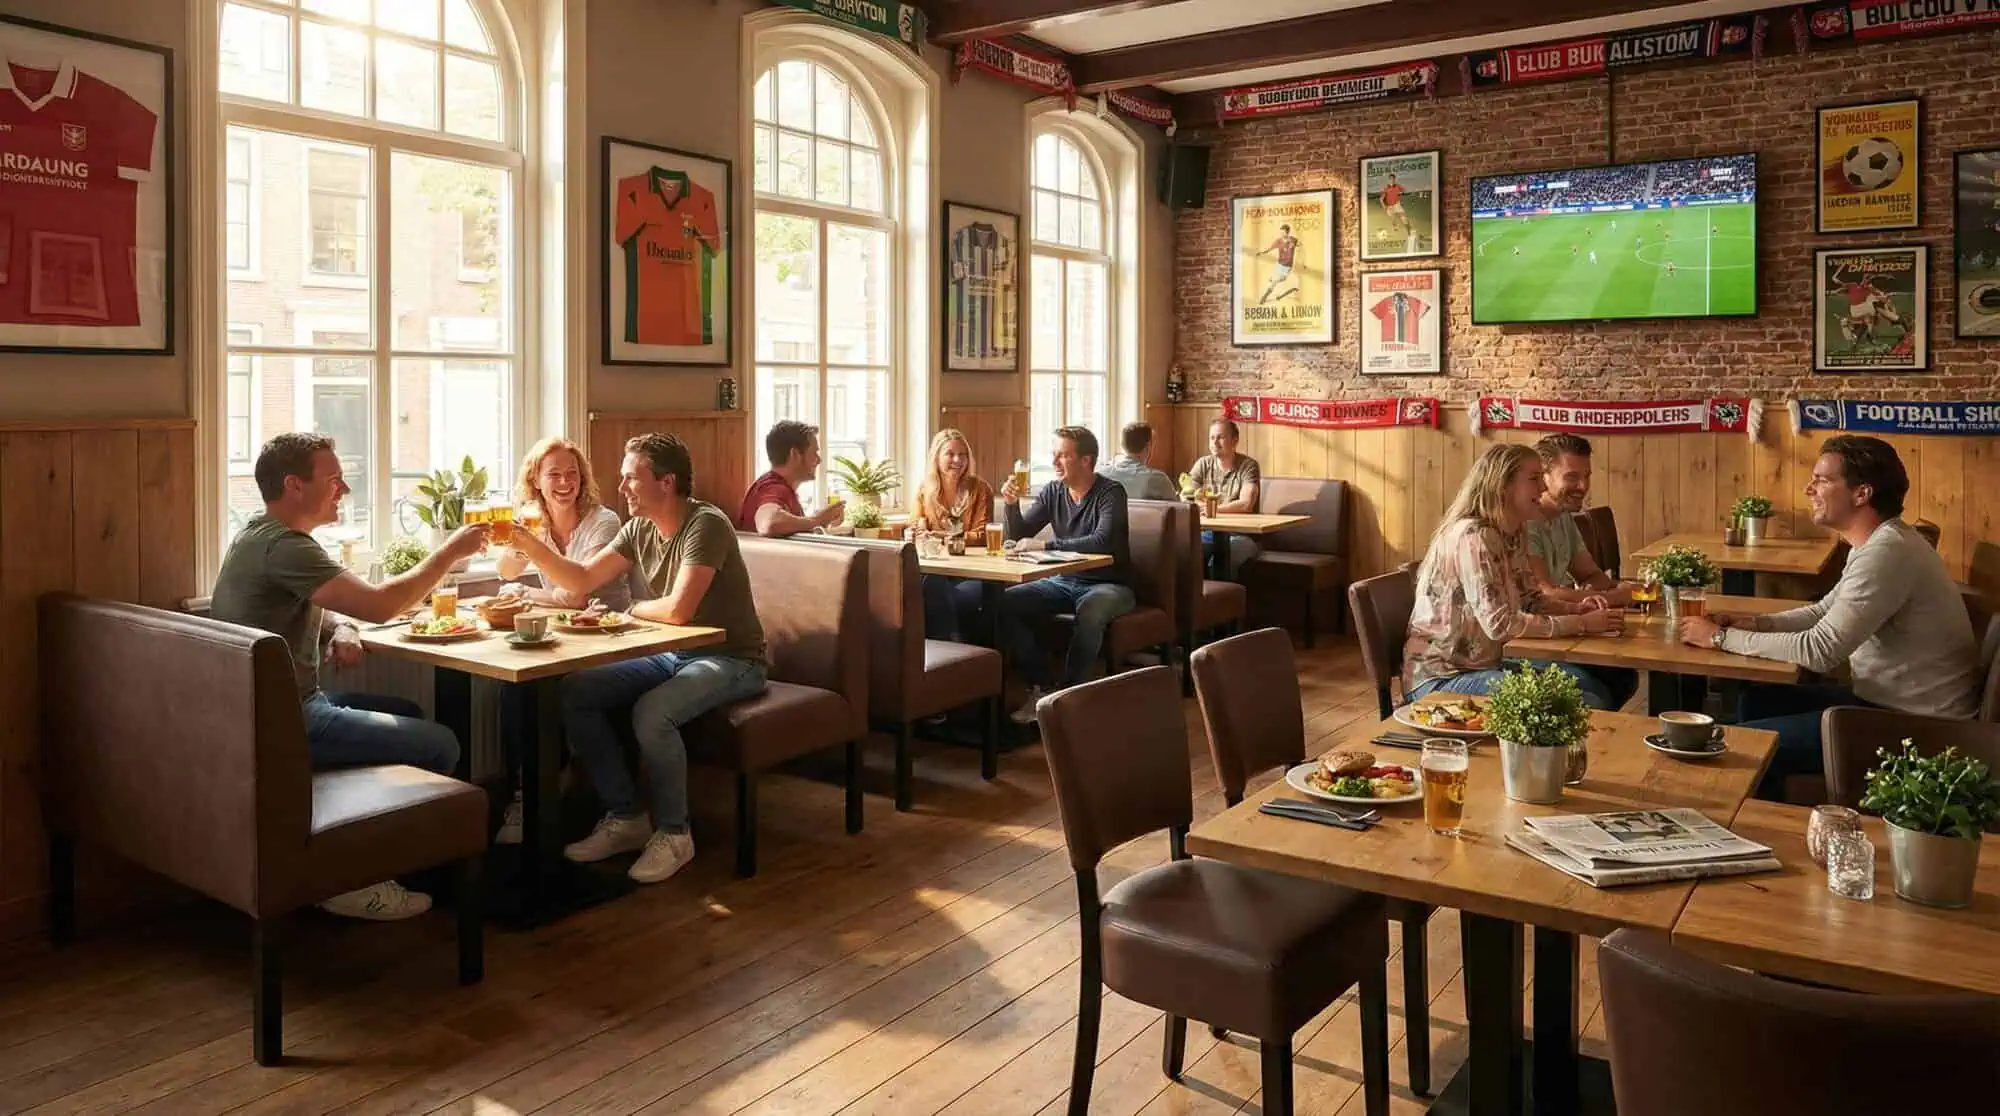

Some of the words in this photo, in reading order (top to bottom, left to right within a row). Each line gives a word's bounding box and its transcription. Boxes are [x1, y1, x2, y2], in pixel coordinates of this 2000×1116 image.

[1517, 49, 1561, 73] CLUB
[1609, 28, 1699, 61] ALLSTOM
[1532, 408, 1569, 423] CLUB
[1855, 404, 1960, 422] FOOTBALL
